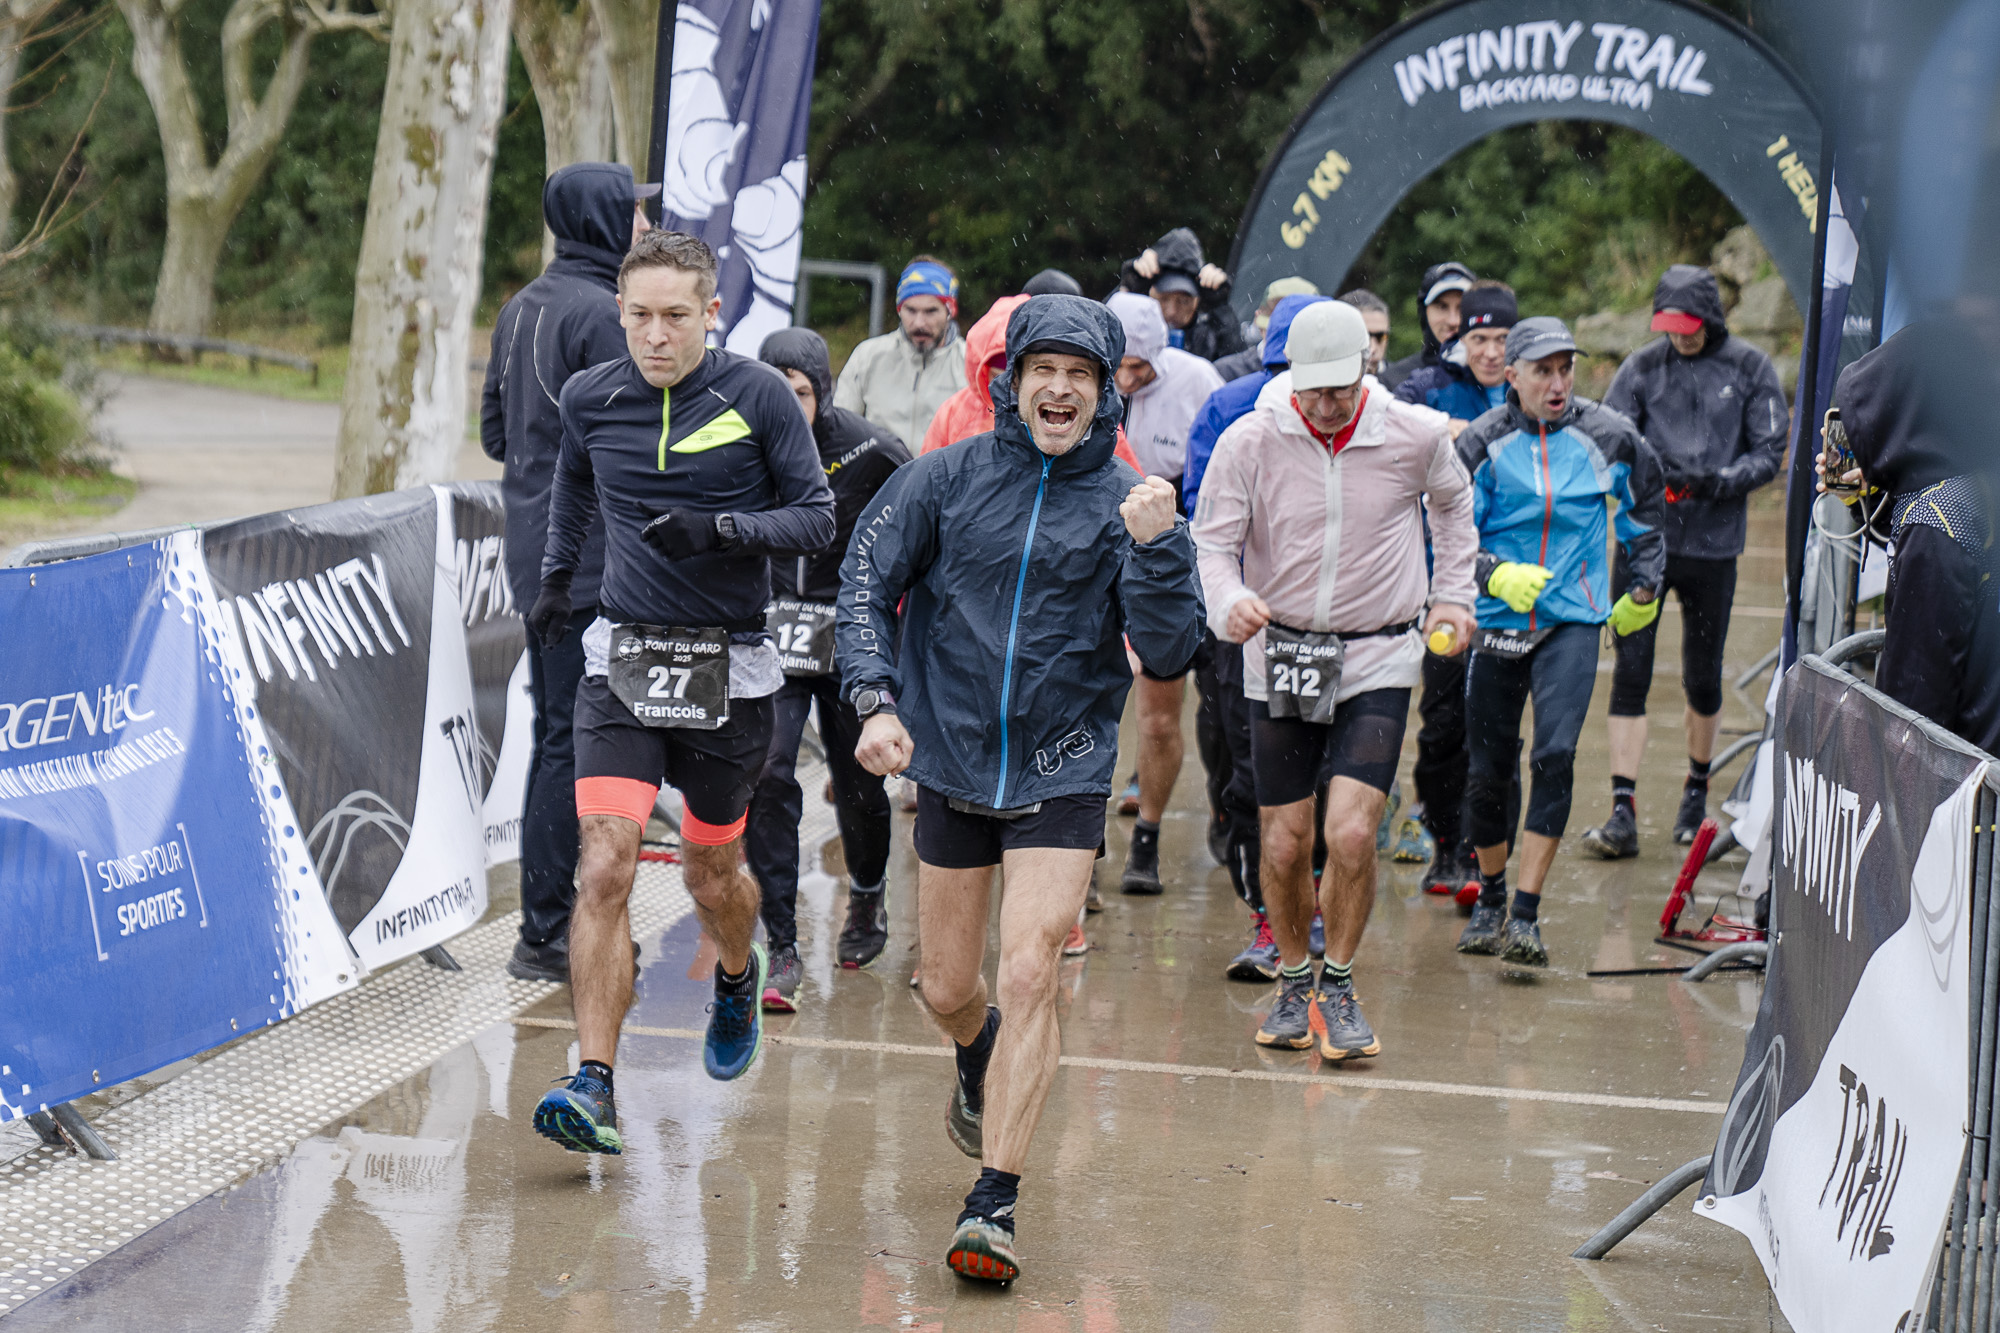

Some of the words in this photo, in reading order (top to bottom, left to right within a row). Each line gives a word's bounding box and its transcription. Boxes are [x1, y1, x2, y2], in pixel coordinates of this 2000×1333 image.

[1393, 19, 1585, 107] INFINITY
[1591, 21, 1715, 97] TRAIL
[1459, 73, 1581, 112] BACKYARD
[1580, 74, 1654, 111] ULTRA
[1307, 149, 1352, 201] KM
[840, 437, 879, 465] ULTRA
[218, 552, 413, 698] INFINITY
[776, 601, 802, 613] PONT
[801, 602, 814, 613] DU
[814, 603, 837, 617] GARD
[644, 640, 673, 653] PONT
[674, 643, 690, 654] DU
[691, 643, 722, 655] GARD
[777, 623, 812, 653] 12
[1276, 641, 1299, 655] PONT
[1298, 643, 1312, 655] DU
[1312, 645, 1338, 658] GARD
[672, 654, 693, 663] 2025
[778, 653, 820, 671] njamin
[647, 665, 692, 699] 27
[1273, 663, 1321, 697] 212
[633, 702, 707, 720] Francois
[92, 726, 185, 783] TECHNOLOGIES
[97, 854, 148, 893] SOINS
[141, 840, 184, 879] POUR
[117, 887, 187, 937] SPORTIFS
[1818, 1063, 1908, 1262] TRAIL
